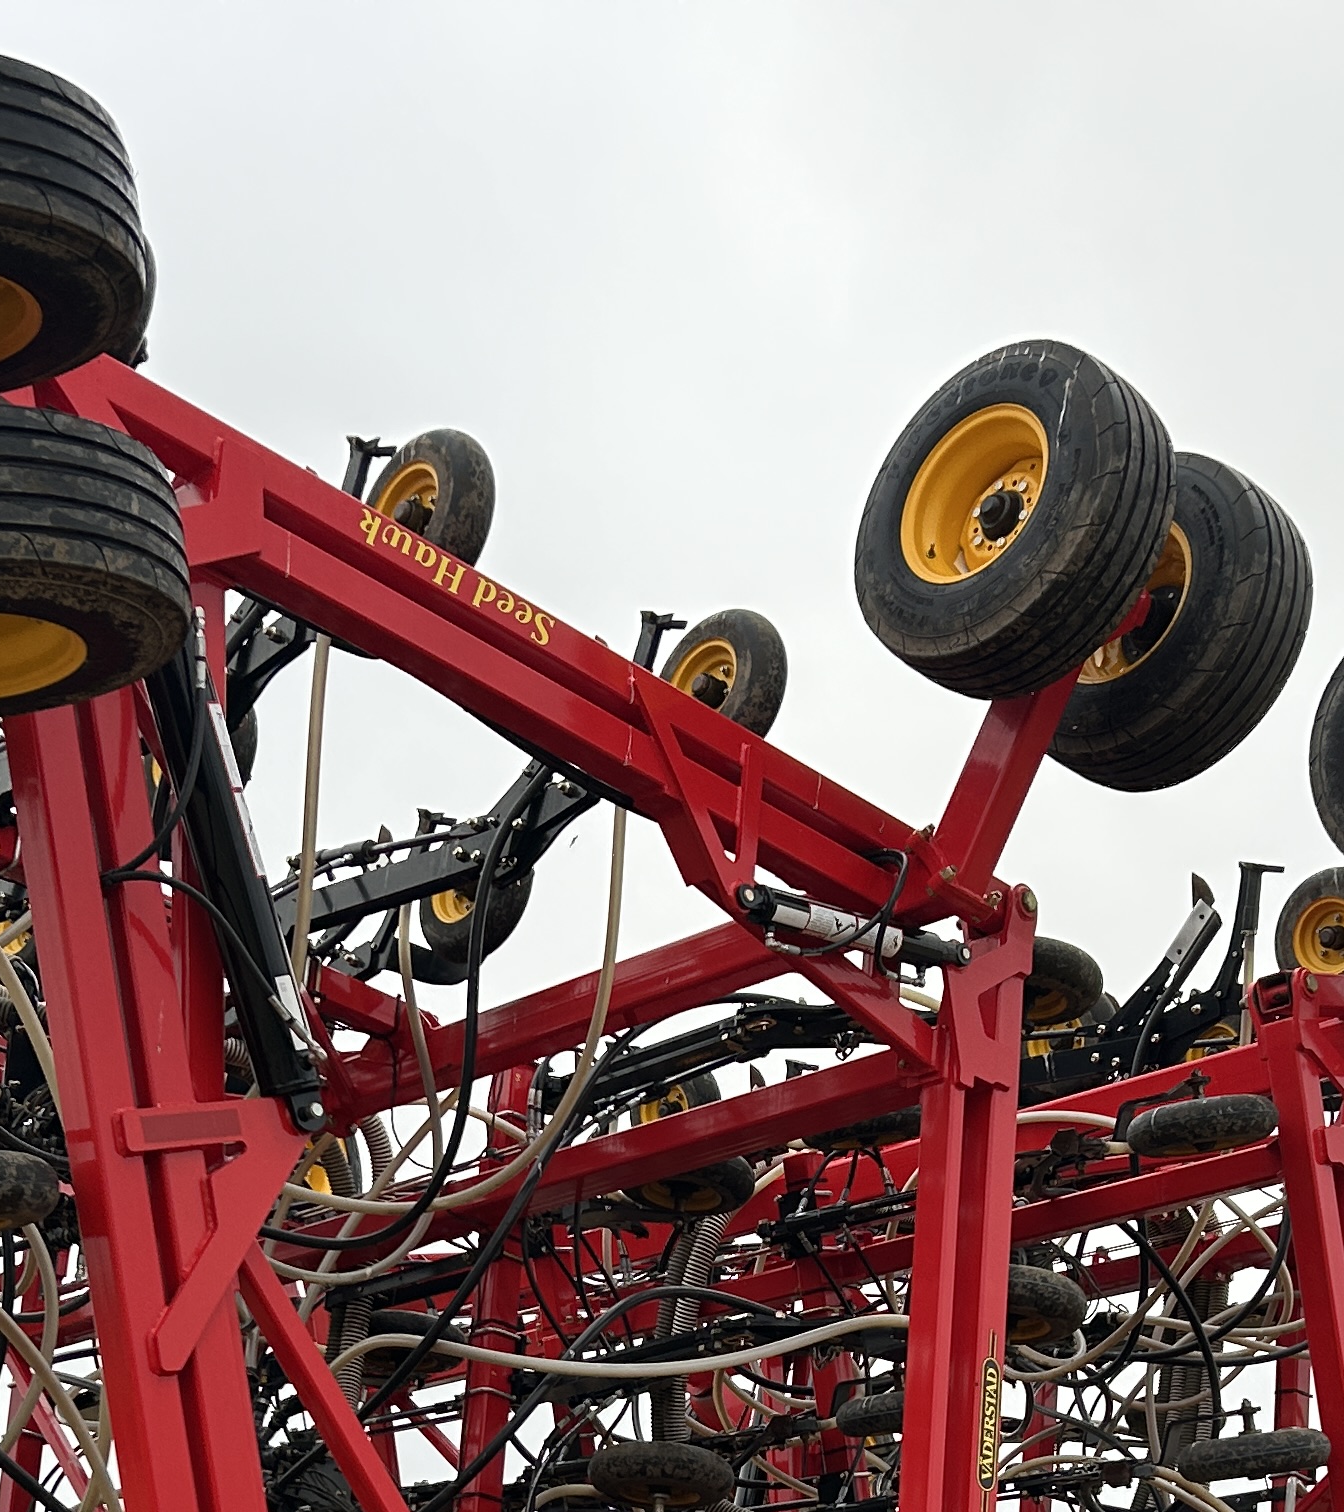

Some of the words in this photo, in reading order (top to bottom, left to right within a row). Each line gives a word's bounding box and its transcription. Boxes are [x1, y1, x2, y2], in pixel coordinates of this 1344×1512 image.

[359, 508, 467, 595] Hawk
[472, 576, 556, 646] Seed
[979, 1366, 998, 1480] VÄDERSTAD
